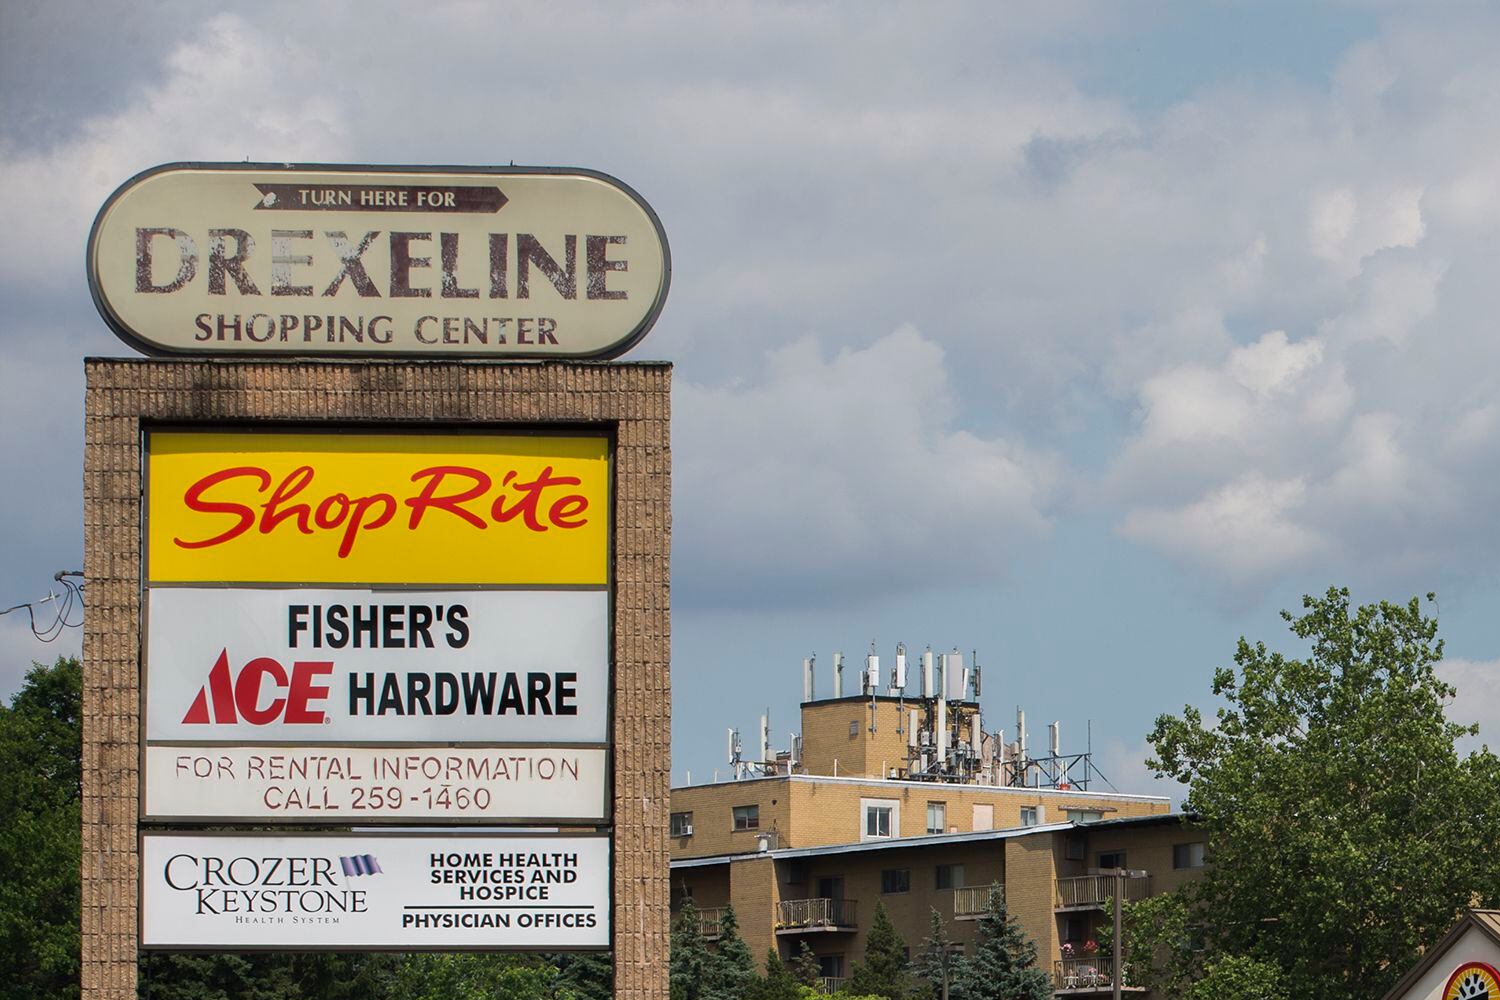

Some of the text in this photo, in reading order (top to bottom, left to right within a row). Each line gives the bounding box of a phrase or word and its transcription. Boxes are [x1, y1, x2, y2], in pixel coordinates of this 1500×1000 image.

[299, 189, 456, 208] TURN HERE FOR
[134, 227, 628, 300] DREXELINE
[195, 313, 559, 345] SHOPPING CENTER
[173, 466, 588, 558] ShopRite
[289, 604, 469, 648] FISHER'S
[181, 647, 578, 725] ACE HARDWARE
[176, 757, 579, 781] FOR RENTAL INFORMATION
[264, 785, 491, 810] CALL 259-1460
[430, 853, 578, 868] HOME HEALTH
[430, 870, 577, 884] SERVICES AND
[195, 889, 368, 914] KEYSTONE
[460, 886, 549, 901] HOSPICE
[402, 913, 597, 929] PHYSICIAN OFFICES
